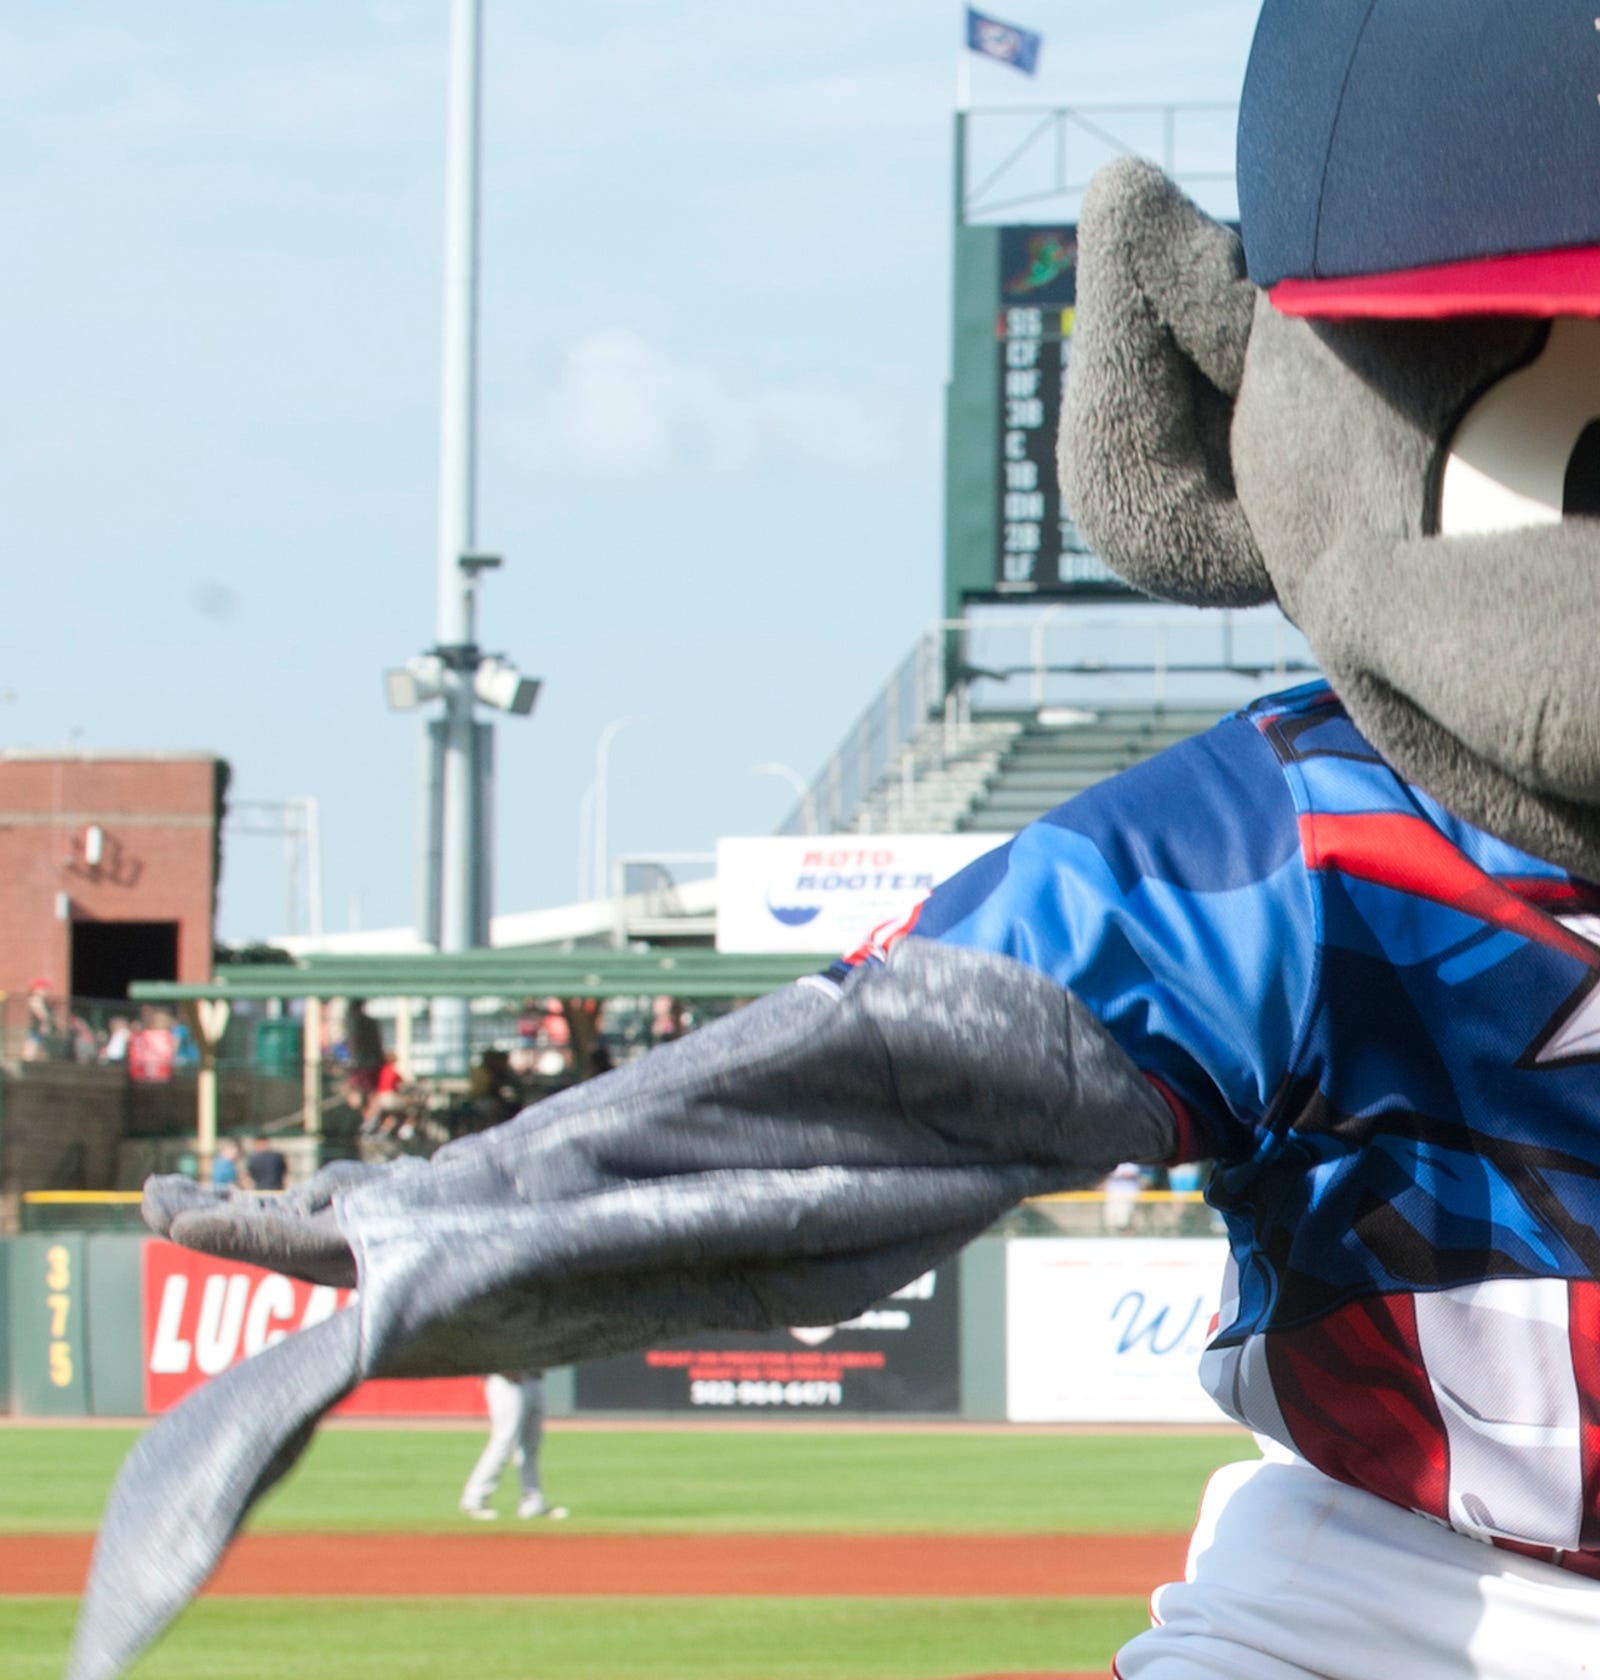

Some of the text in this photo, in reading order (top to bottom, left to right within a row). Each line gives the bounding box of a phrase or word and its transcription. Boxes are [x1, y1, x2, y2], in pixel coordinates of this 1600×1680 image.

[801, 849, 896, 868] ROTO
[794, 871, 934, 892] ROOTER
[46, 1244, 73, 1388] 375
